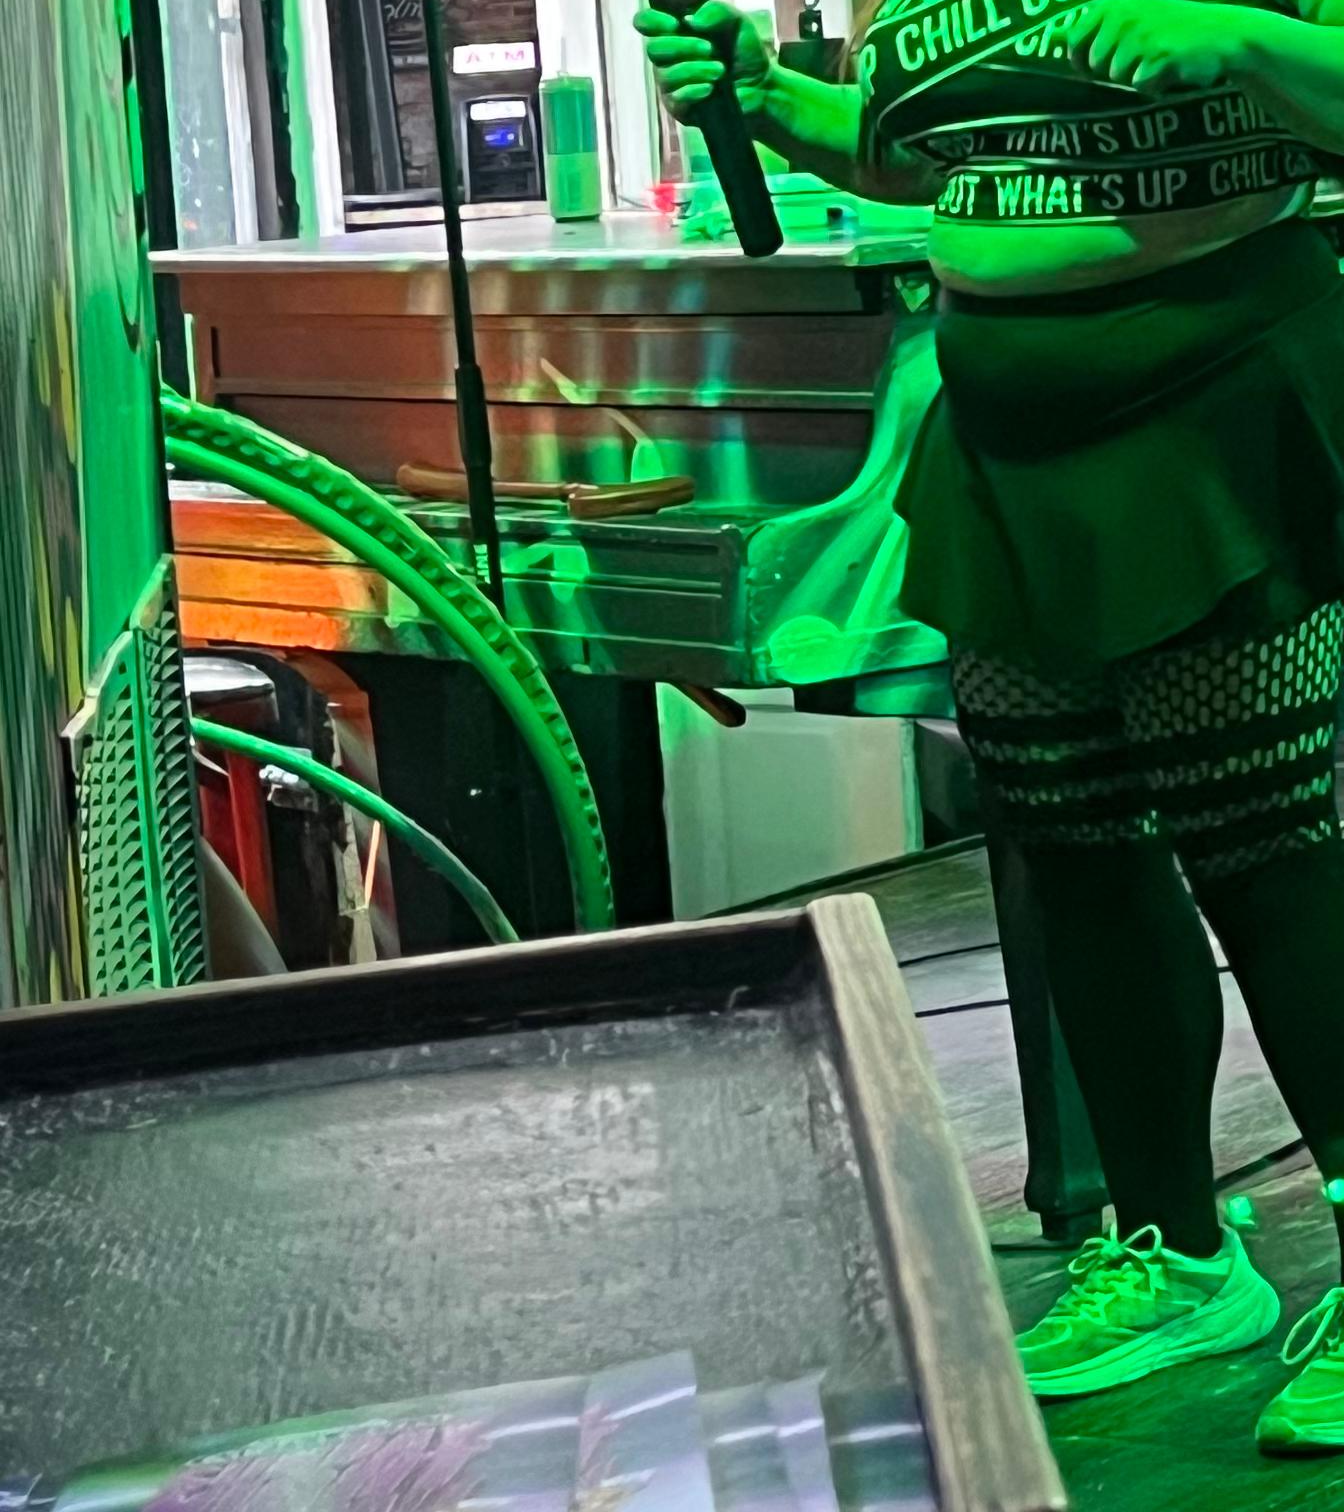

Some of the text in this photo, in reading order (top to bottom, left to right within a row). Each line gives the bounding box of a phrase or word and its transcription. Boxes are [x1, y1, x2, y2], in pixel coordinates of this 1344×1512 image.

[1127, 109, 1179, 150] UP
[1202, 96, 1279, 137] CHIL
[994, 172, 1125, 217] WHAT'S
[1137, 167, 1188, 208] UP
